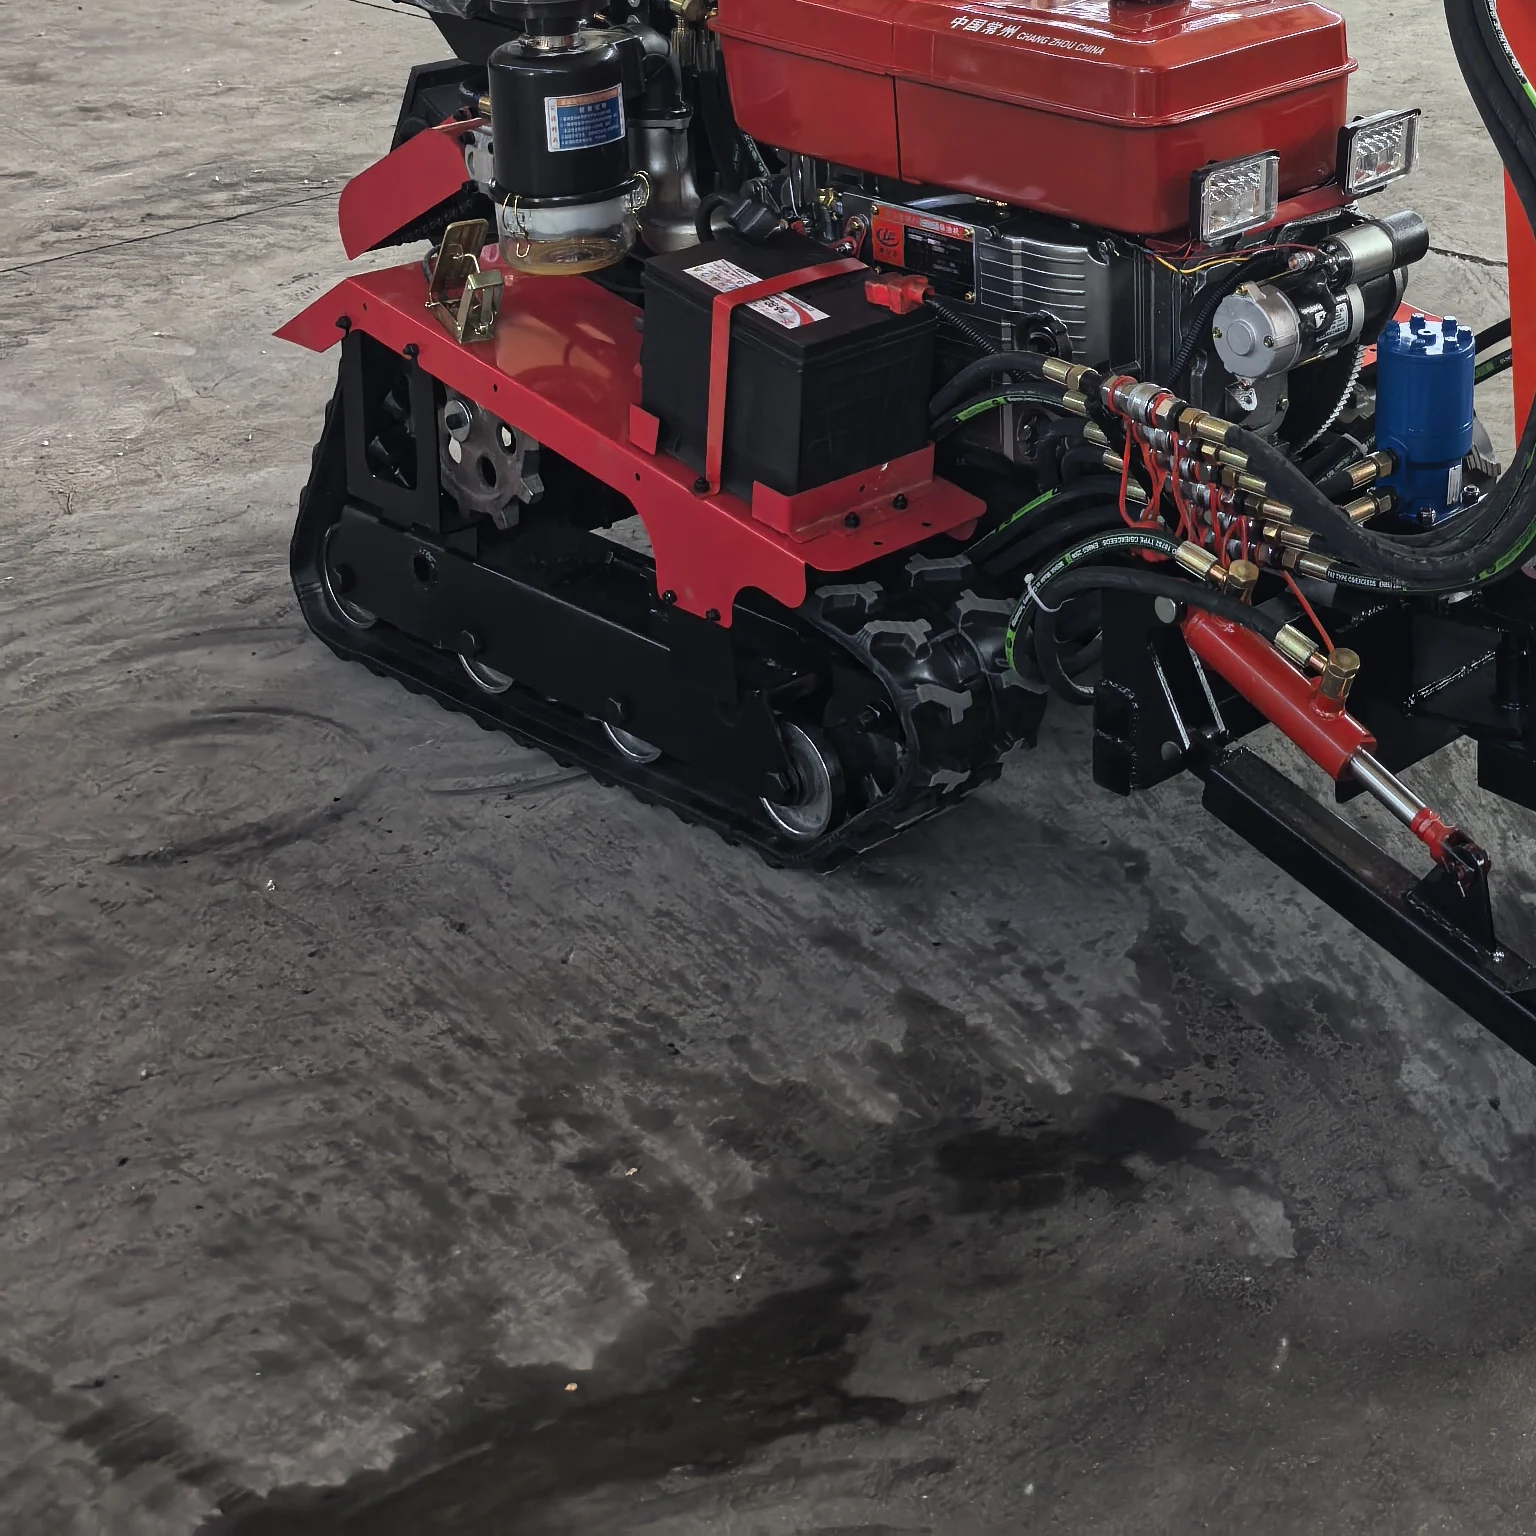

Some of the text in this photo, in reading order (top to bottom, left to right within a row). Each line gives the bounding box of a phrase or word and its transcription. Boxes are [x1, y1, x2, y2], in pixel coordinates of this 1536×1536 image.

[950, 16, 1021, 39] 中国常州
[1016, 32, 1105, 56] CHANG ZHOU CHINA
